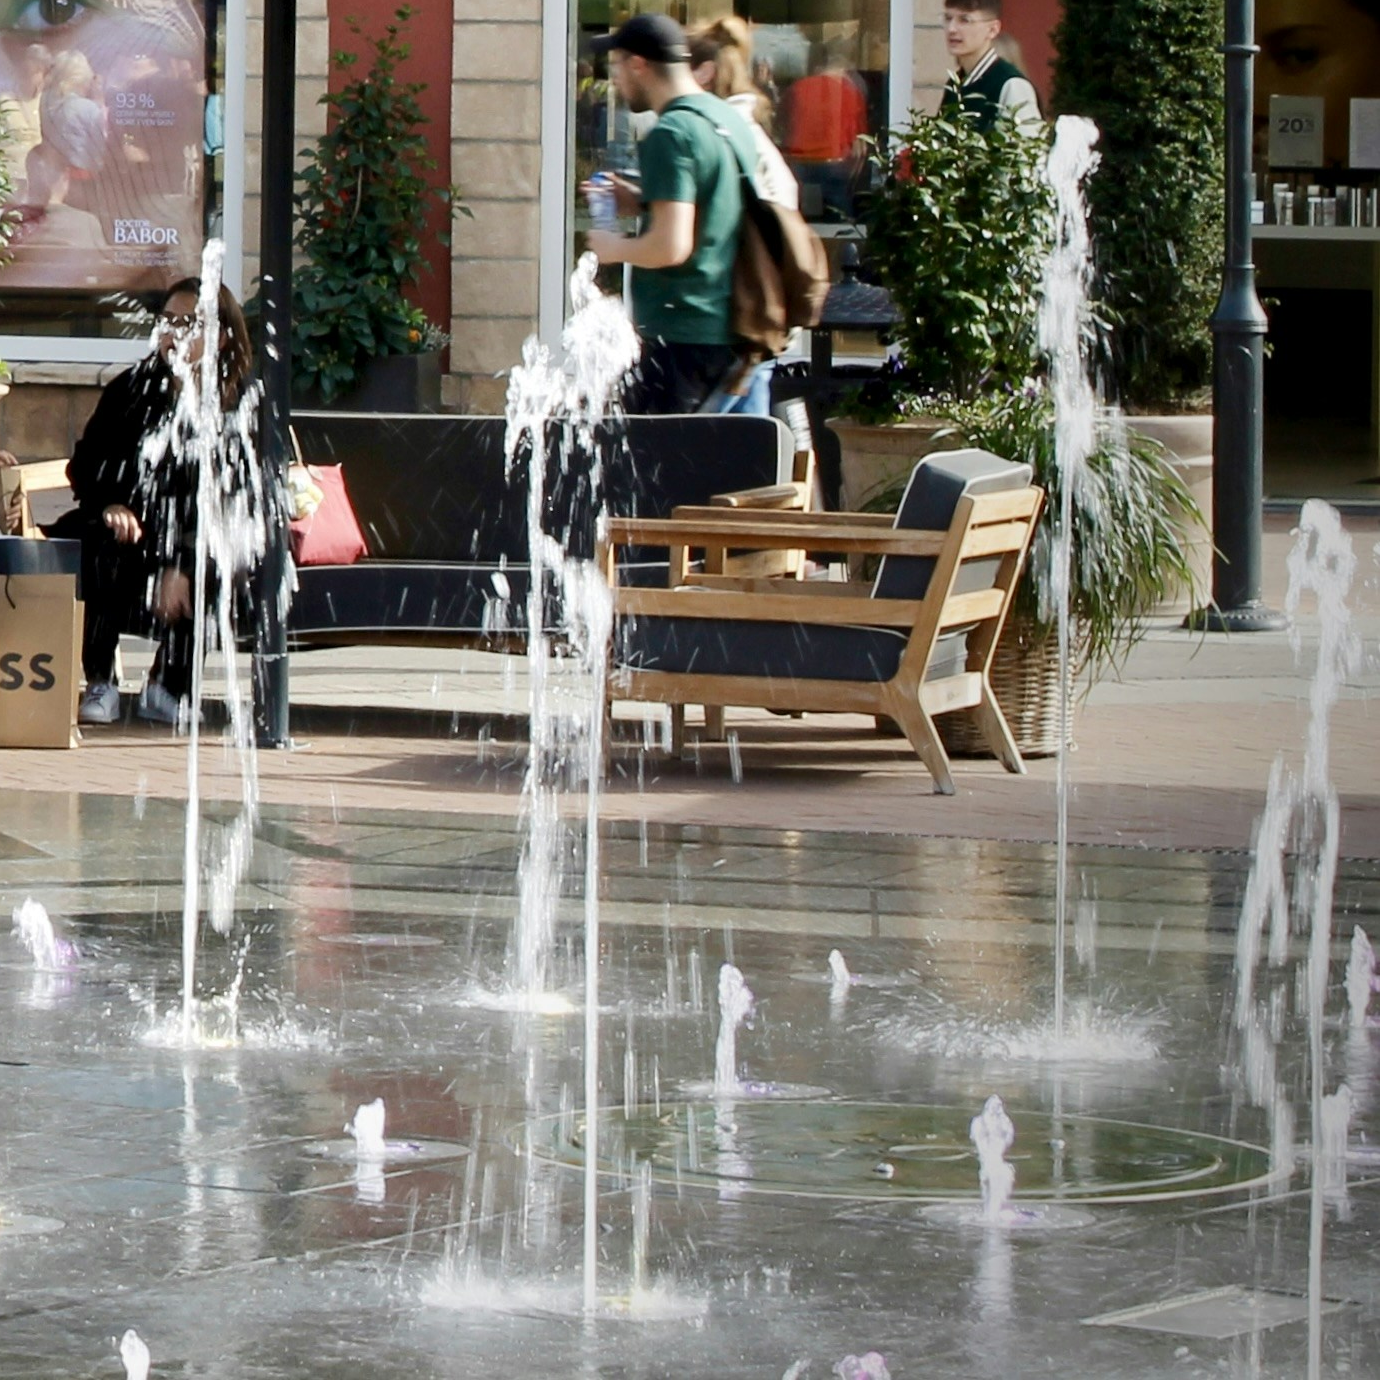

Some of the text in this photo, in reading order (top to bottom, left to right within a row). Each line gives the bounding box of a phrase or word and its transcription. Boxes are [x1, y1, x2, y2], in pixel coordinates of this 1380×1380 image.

[116, 93, 155, 108] 93 %
[114, 219, 150, 227] DOCTOR
[114, 227, 179, 244] BABOR
